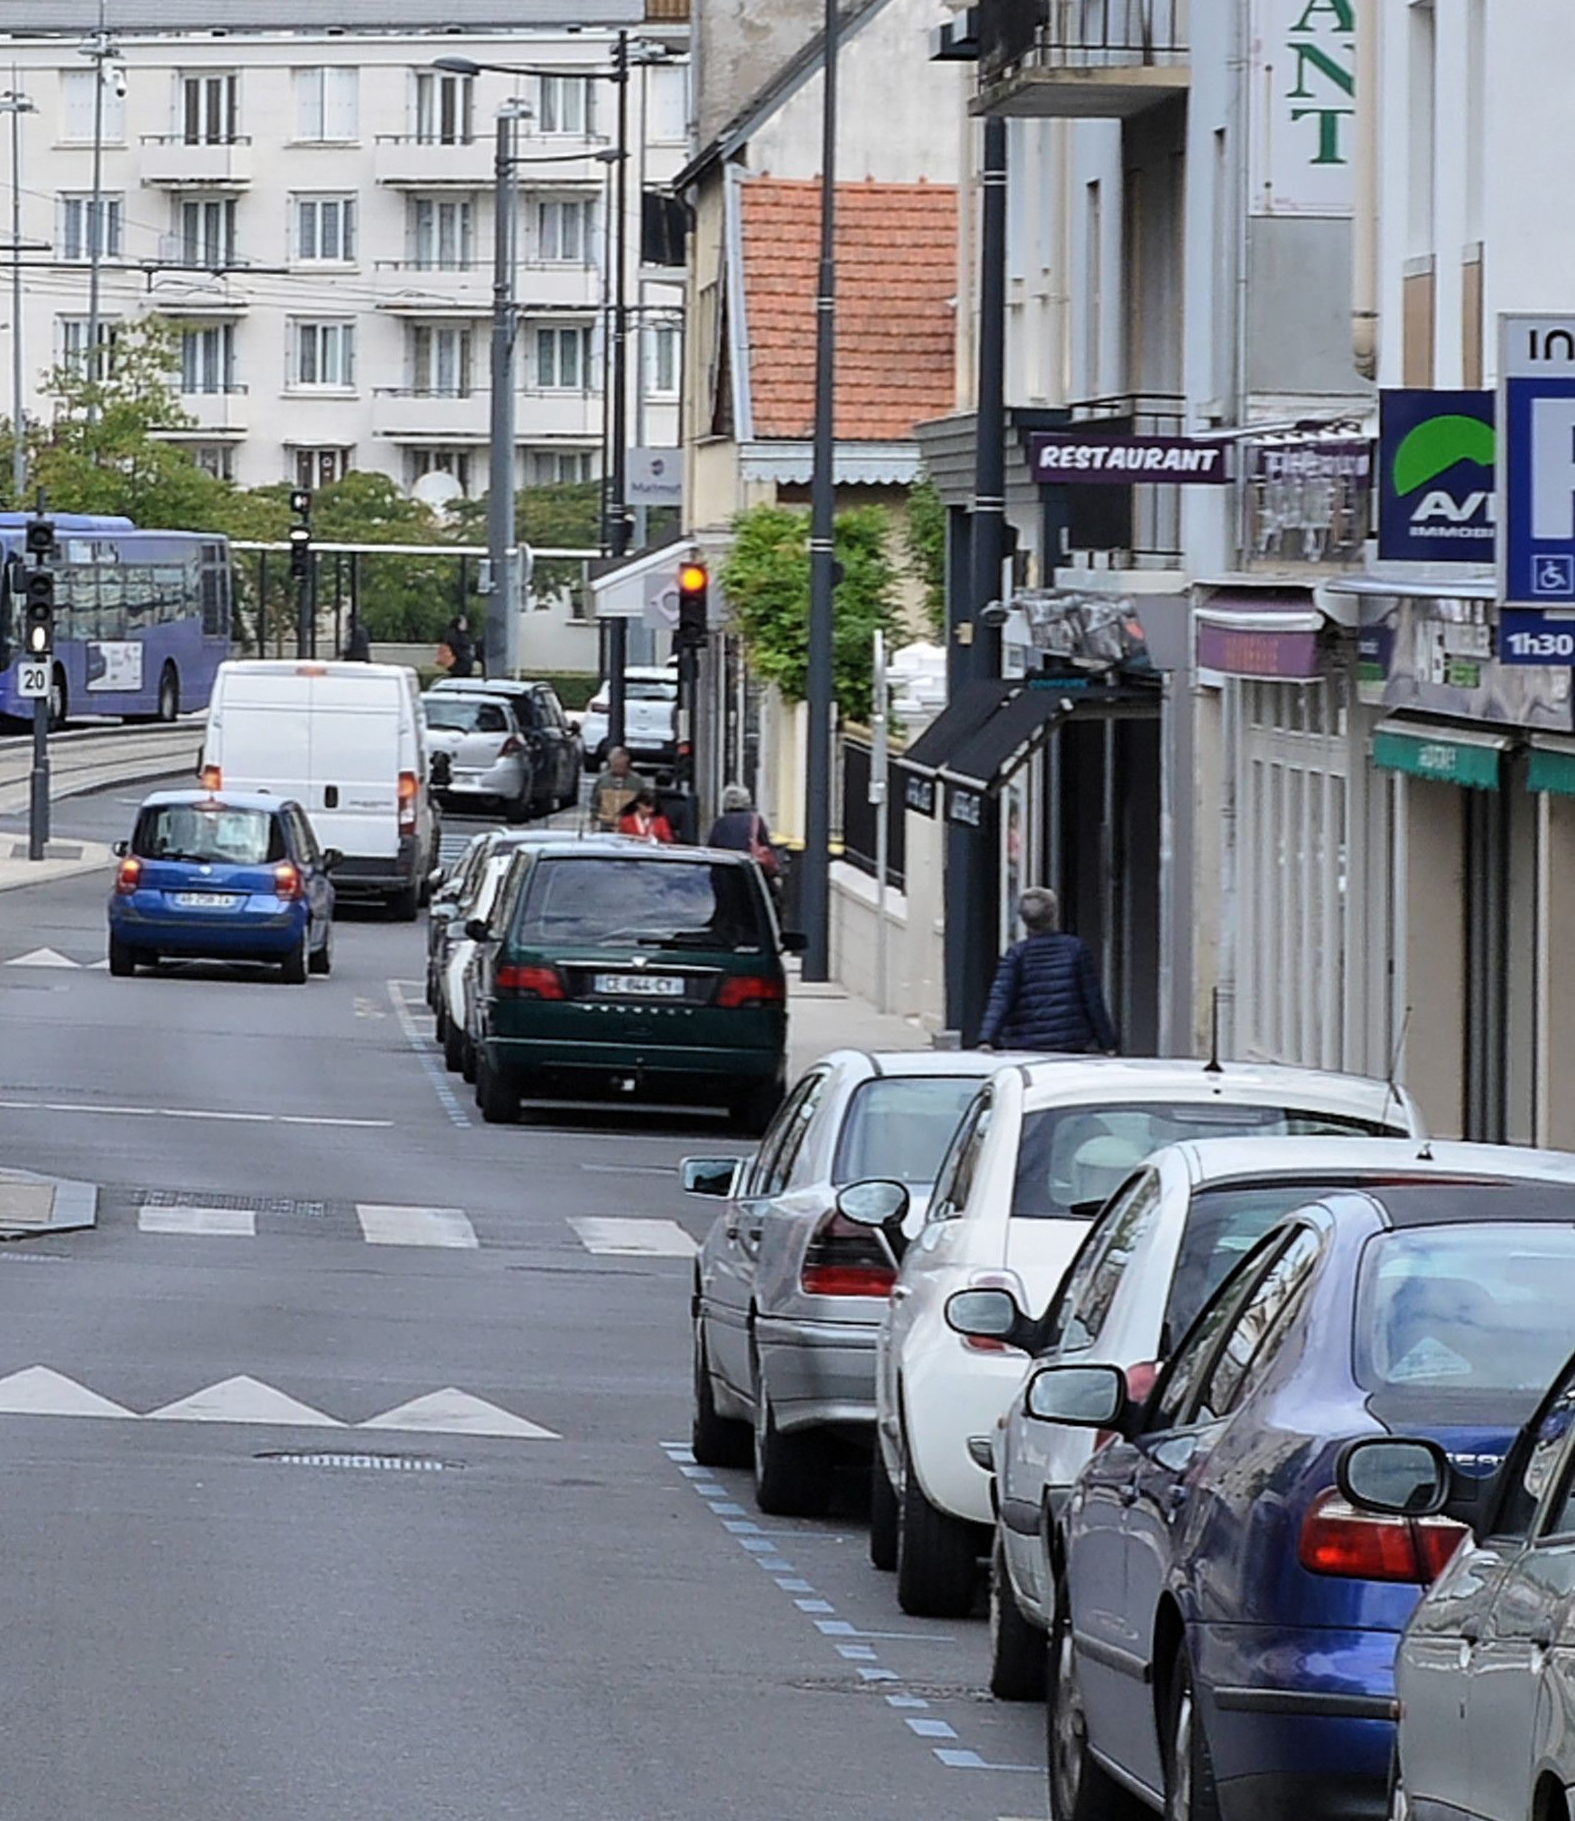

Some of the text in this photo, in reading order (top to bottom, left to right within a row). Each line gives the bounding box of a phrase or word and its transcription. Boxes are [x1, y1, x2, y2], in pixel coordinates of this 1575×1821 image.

[1039, 445, 1220, 472] RESTAURANT
[1507, 633, 1574, 656] 1h30
[24, 669, 45, 690] 20
